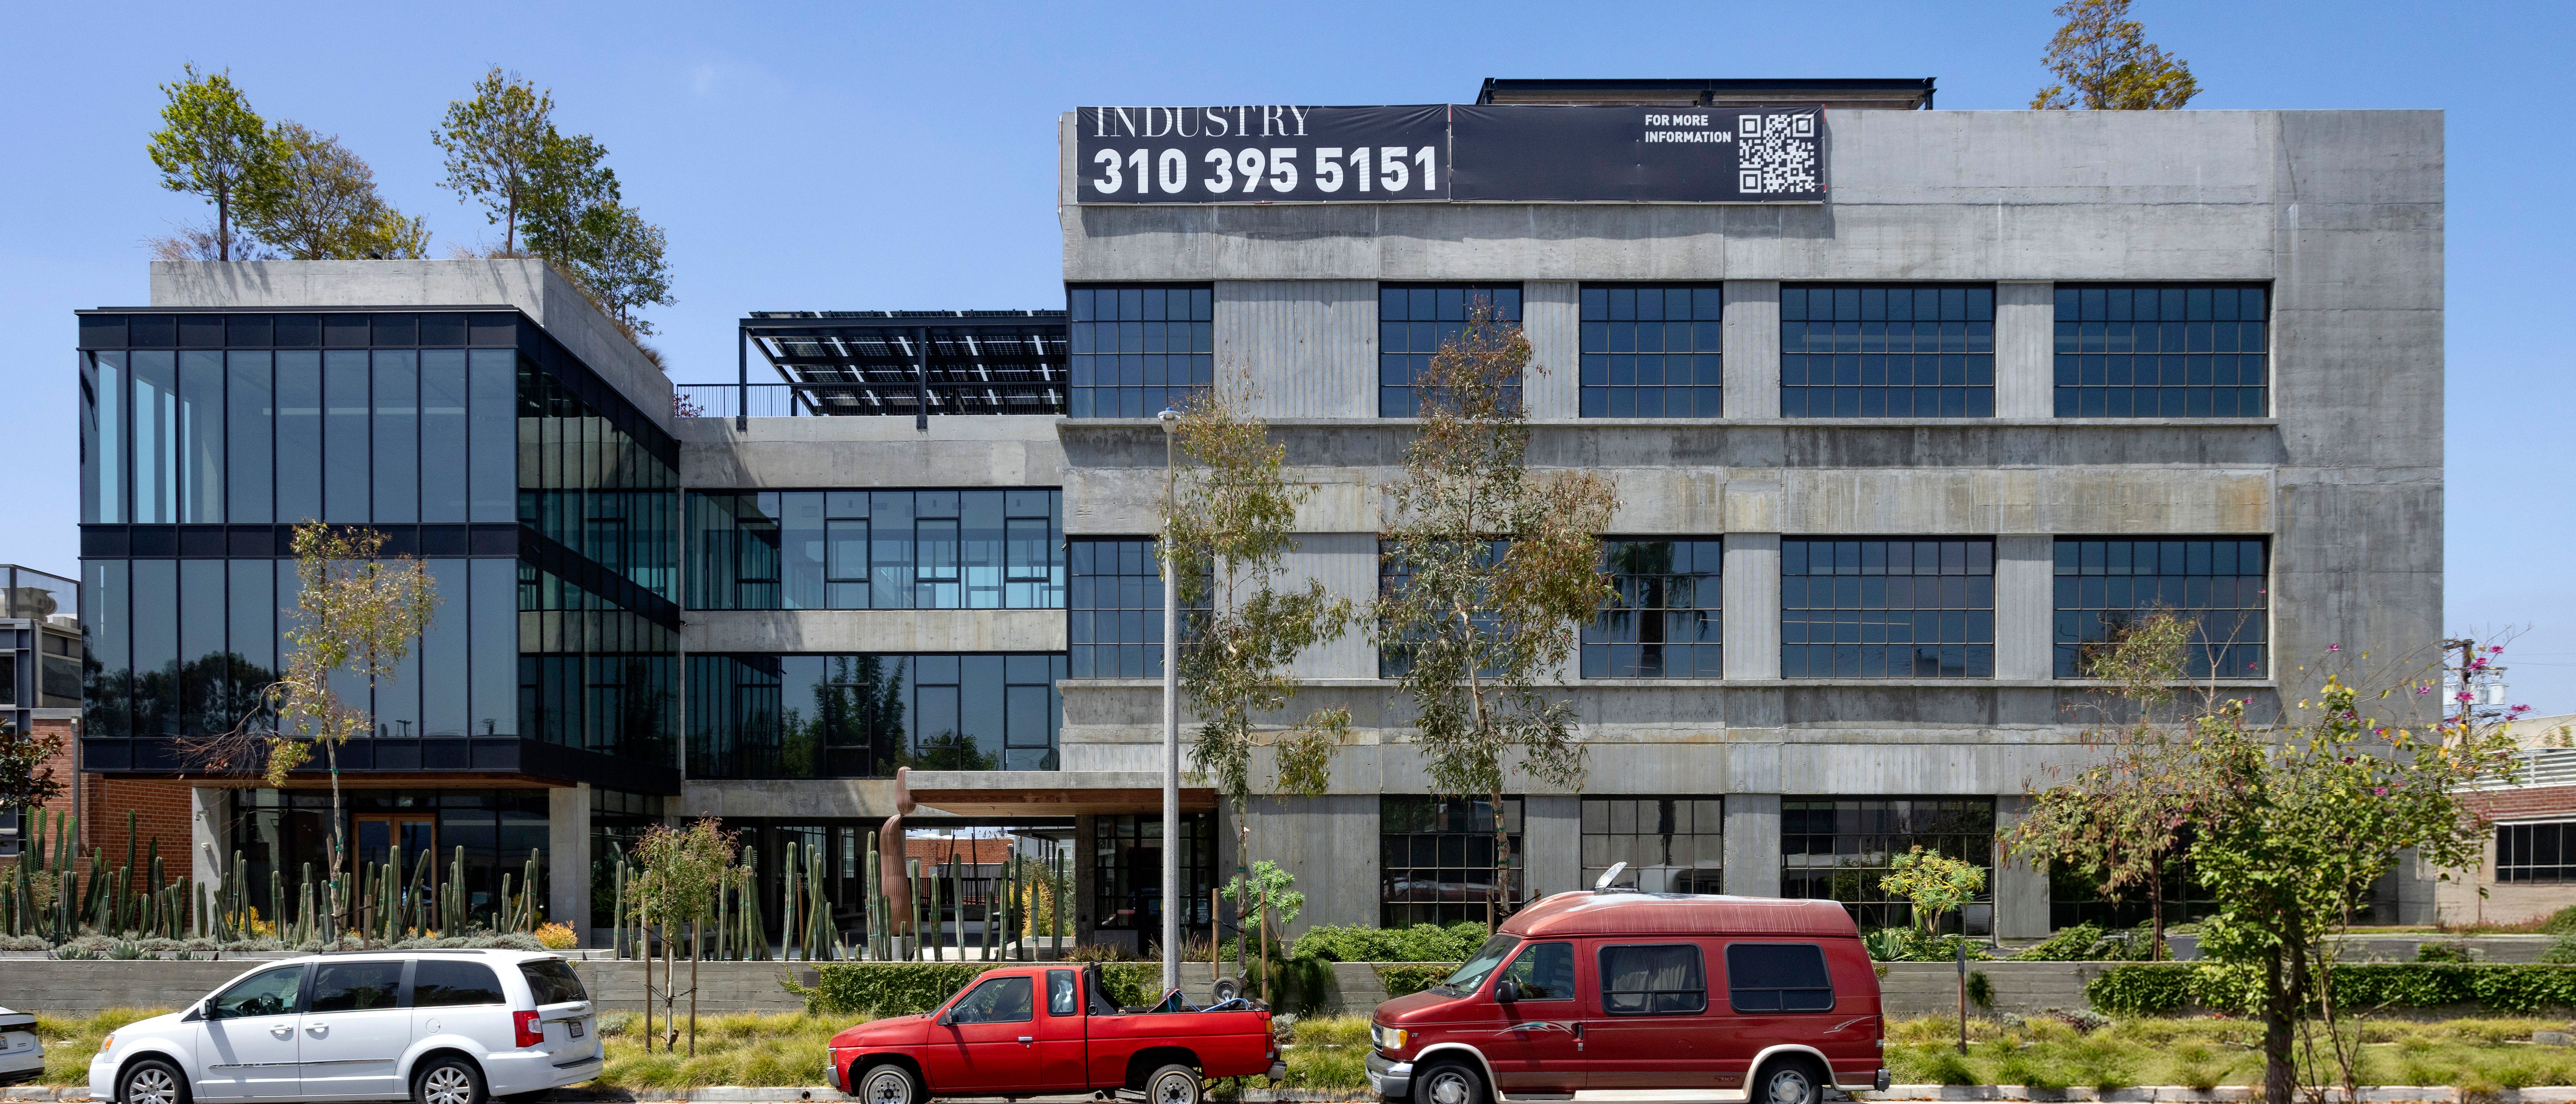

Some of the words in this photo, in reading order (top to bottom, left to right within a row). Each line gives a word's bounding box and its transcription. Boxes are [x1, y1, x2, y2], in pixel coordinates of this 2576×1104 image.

[1093, 105, 1311, 137] INDUSTRY
[1645, 114, 1669, 126] FOR
[1673, 114, 1708, 126] MORE
[1645, 131, 1731, 142] INFORMATION
[1094, 148, 1187, 194] 310
[1204, 148, 1298, 193] 395
[1315, 146, 1435, 192] 5151
